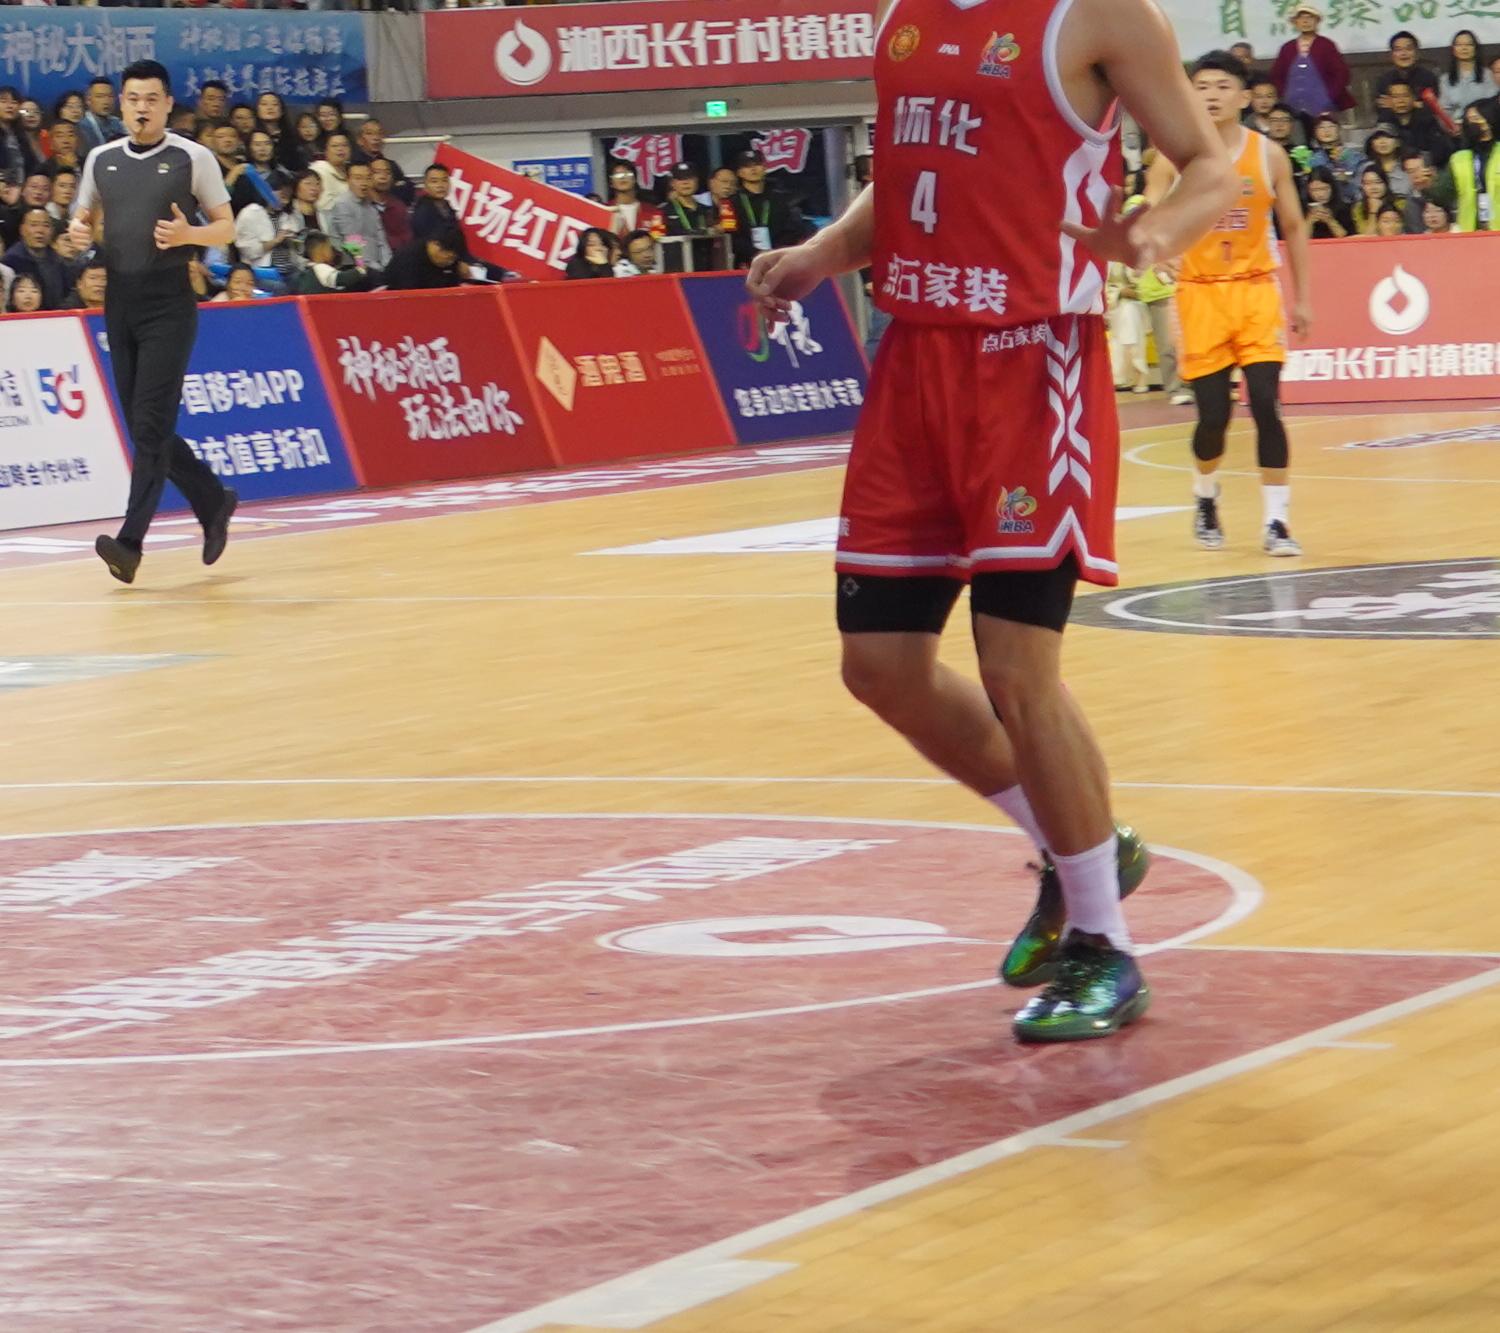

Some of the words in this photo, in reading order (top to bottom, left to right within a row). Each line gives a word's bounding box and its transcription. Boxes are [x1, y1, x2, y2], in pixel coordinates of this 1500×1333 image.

[909, 170, 940, 234] 4
[37, 363, 87, 421] 5G
[338, 334, 463, 394] 神秘湘西
